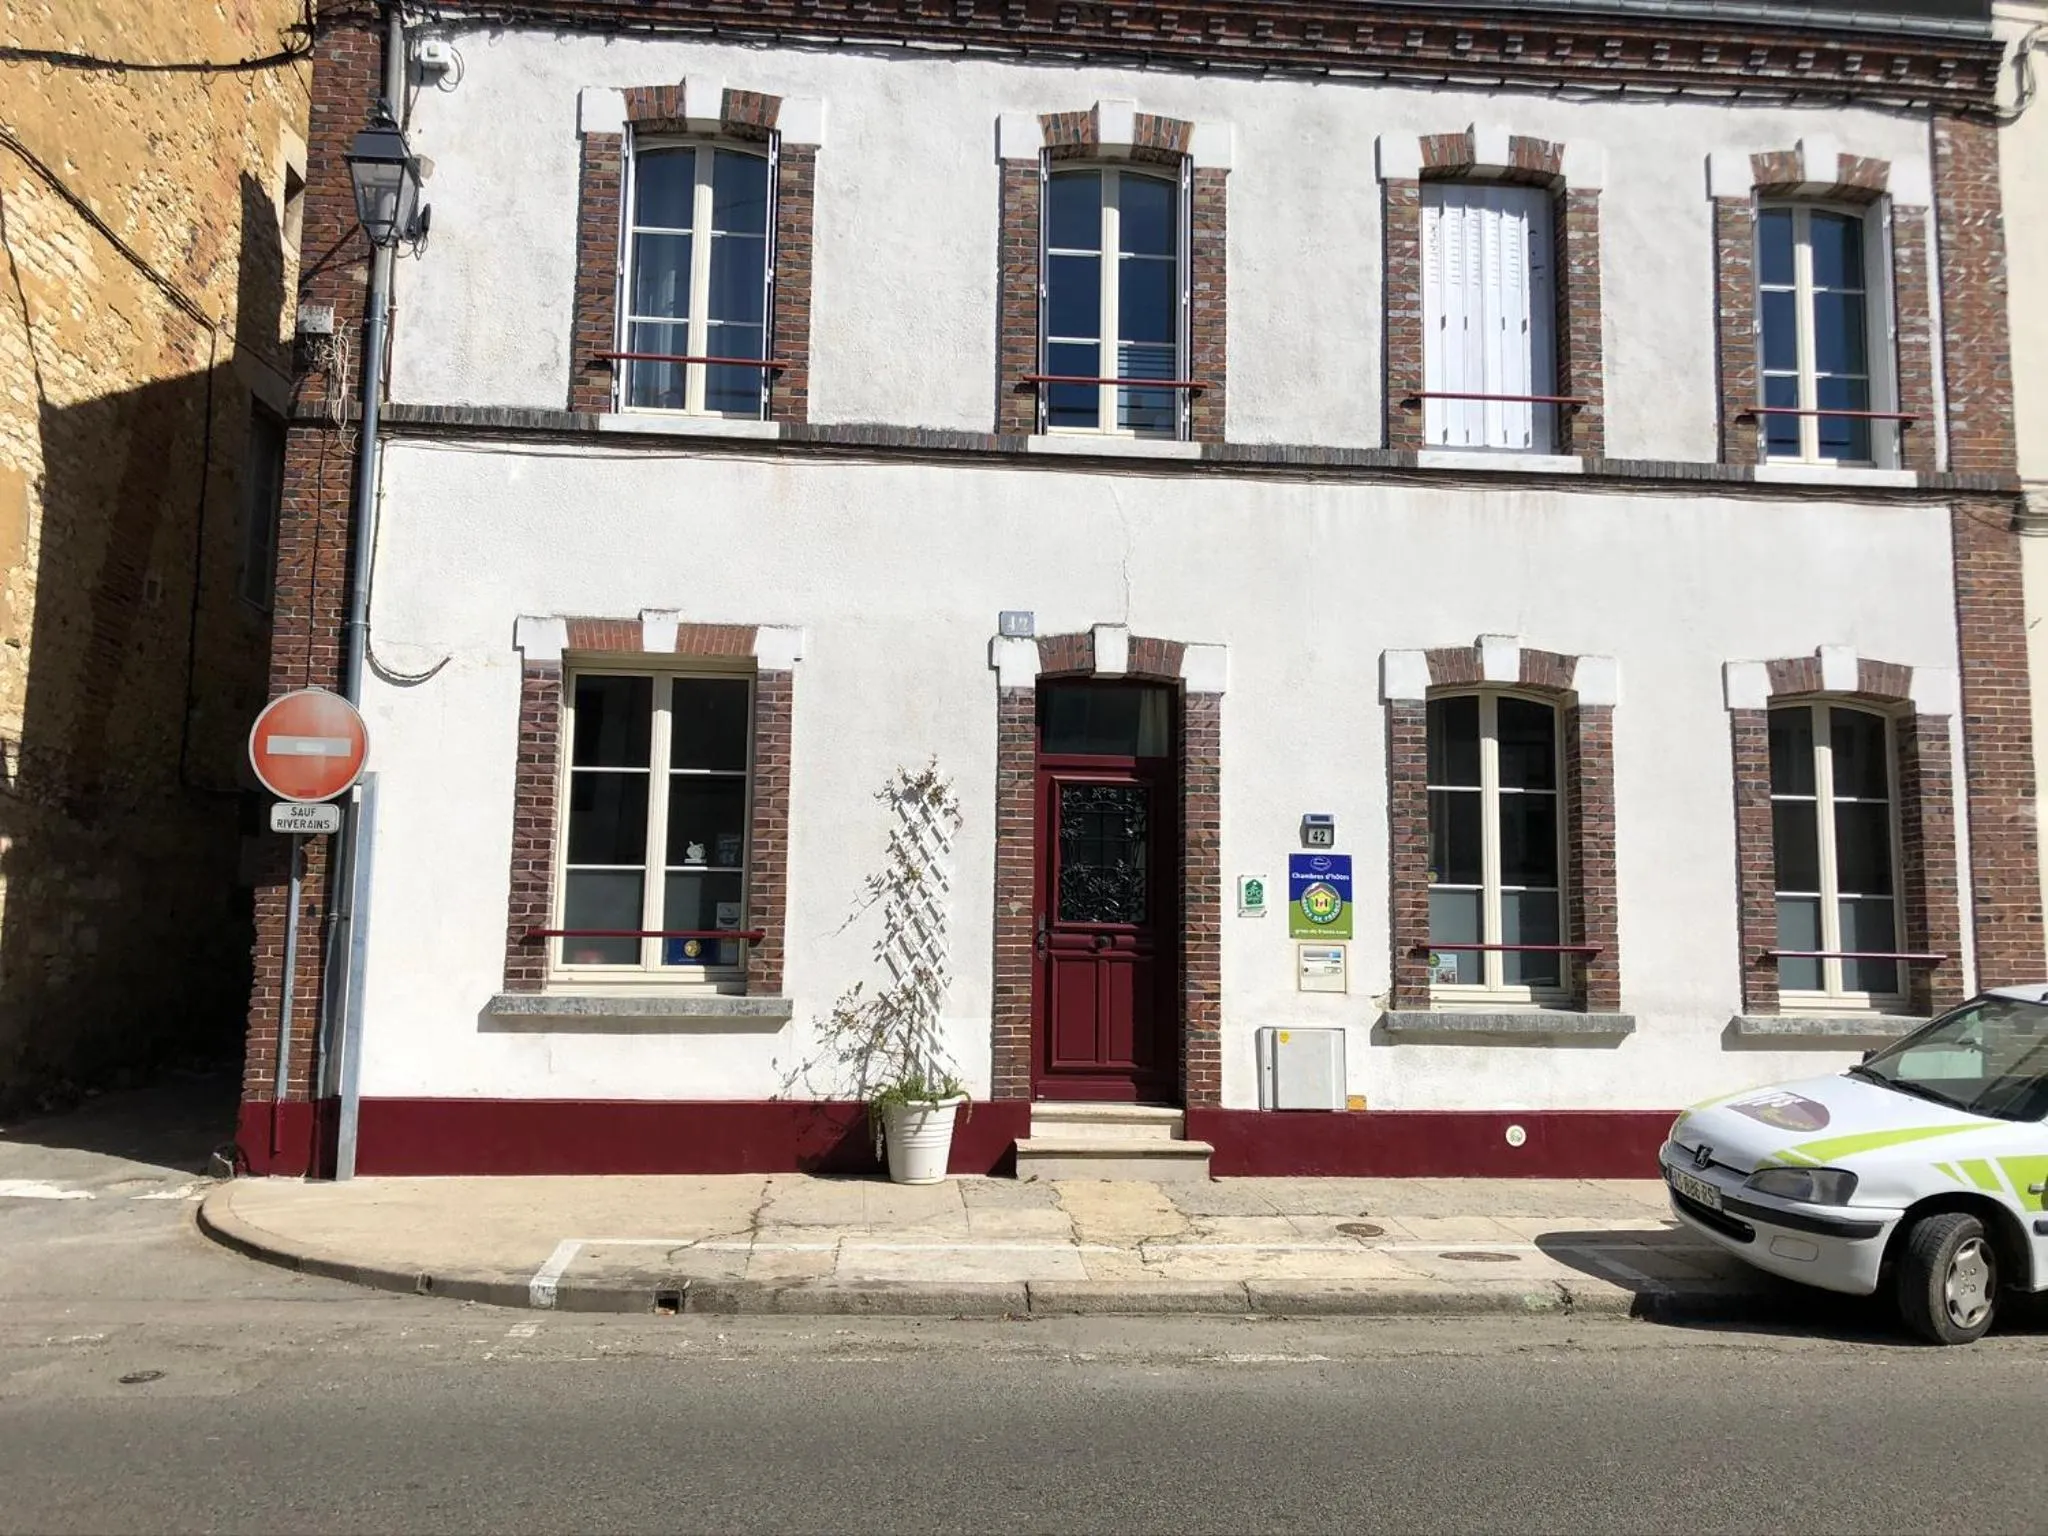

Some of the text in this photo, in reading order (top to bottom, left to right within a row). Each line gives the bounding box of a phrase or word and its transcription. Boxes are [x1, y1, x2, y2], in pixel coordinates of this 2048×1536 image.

[290, 806, 317, 817] SAUF
[276, 818, 330, 829] RIVERAINS
[1312, 831, 1325, 842] 42
